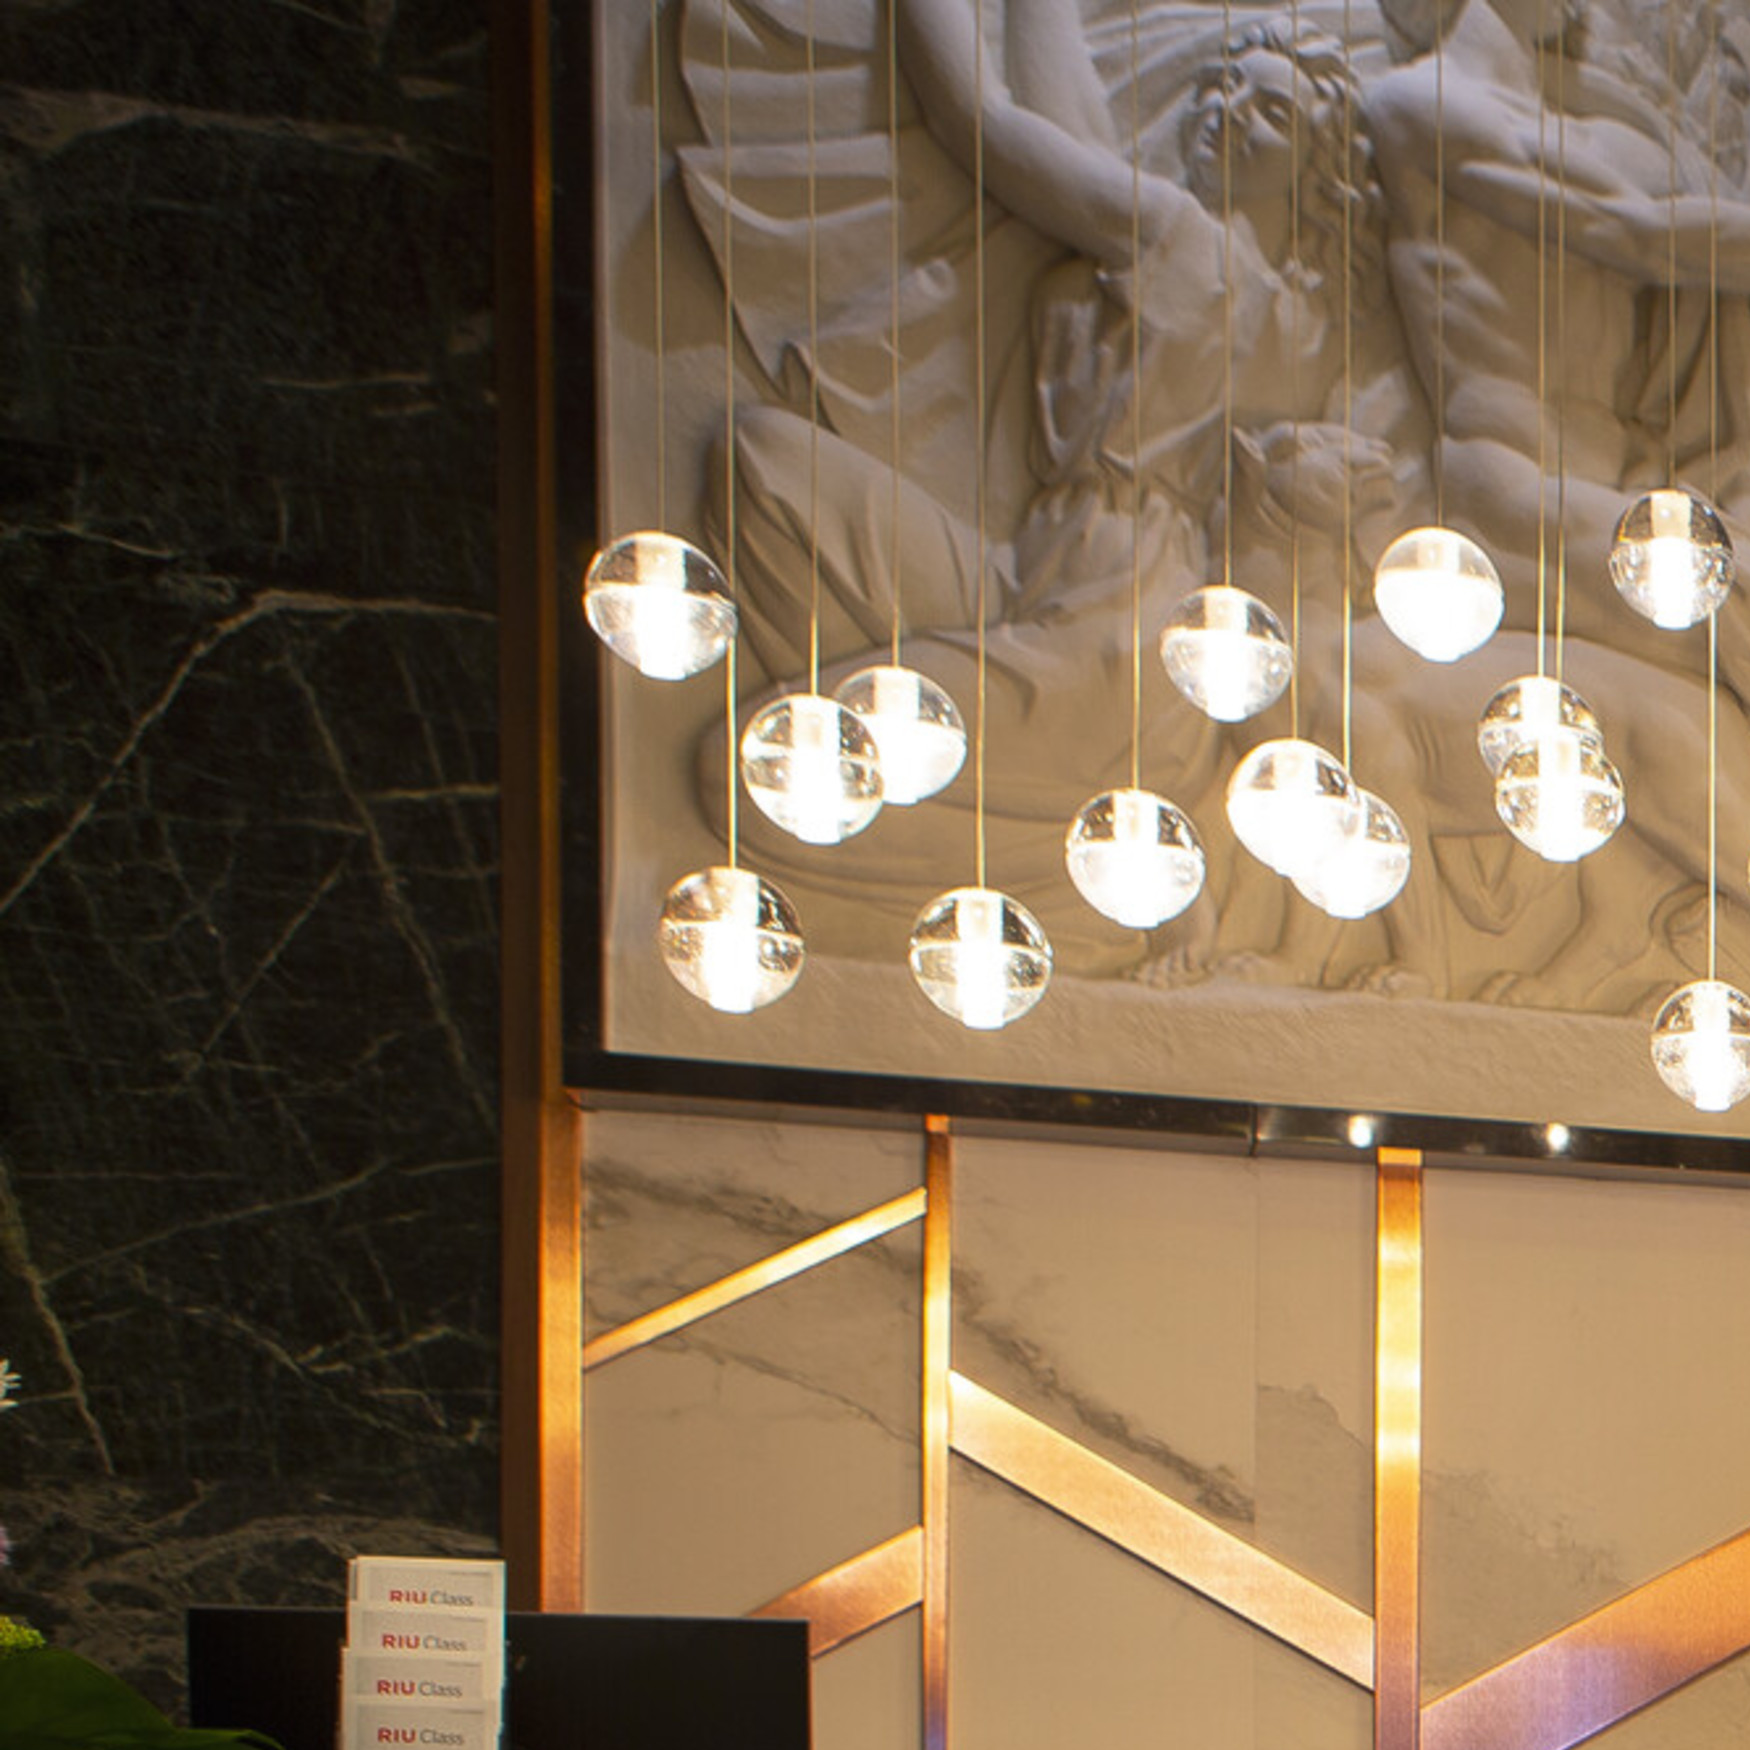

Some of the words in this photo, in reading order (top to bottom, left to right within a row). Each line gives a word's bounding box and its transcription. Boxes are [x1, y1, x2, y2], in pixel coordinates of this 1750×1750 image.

[389, 1589, 427, 1604] RIU
[430, 1590, 474, 1606] Class
[382, 1633, 420, 1649] RIU
[422, 1635, 467, 1651] Class
[377, 1679, 415, 1695] RIU
[418, 1681, 462, 1698] Class
[377, 1727, 416, 1743] RIU
[419, 1729, 464, 1745] Class
